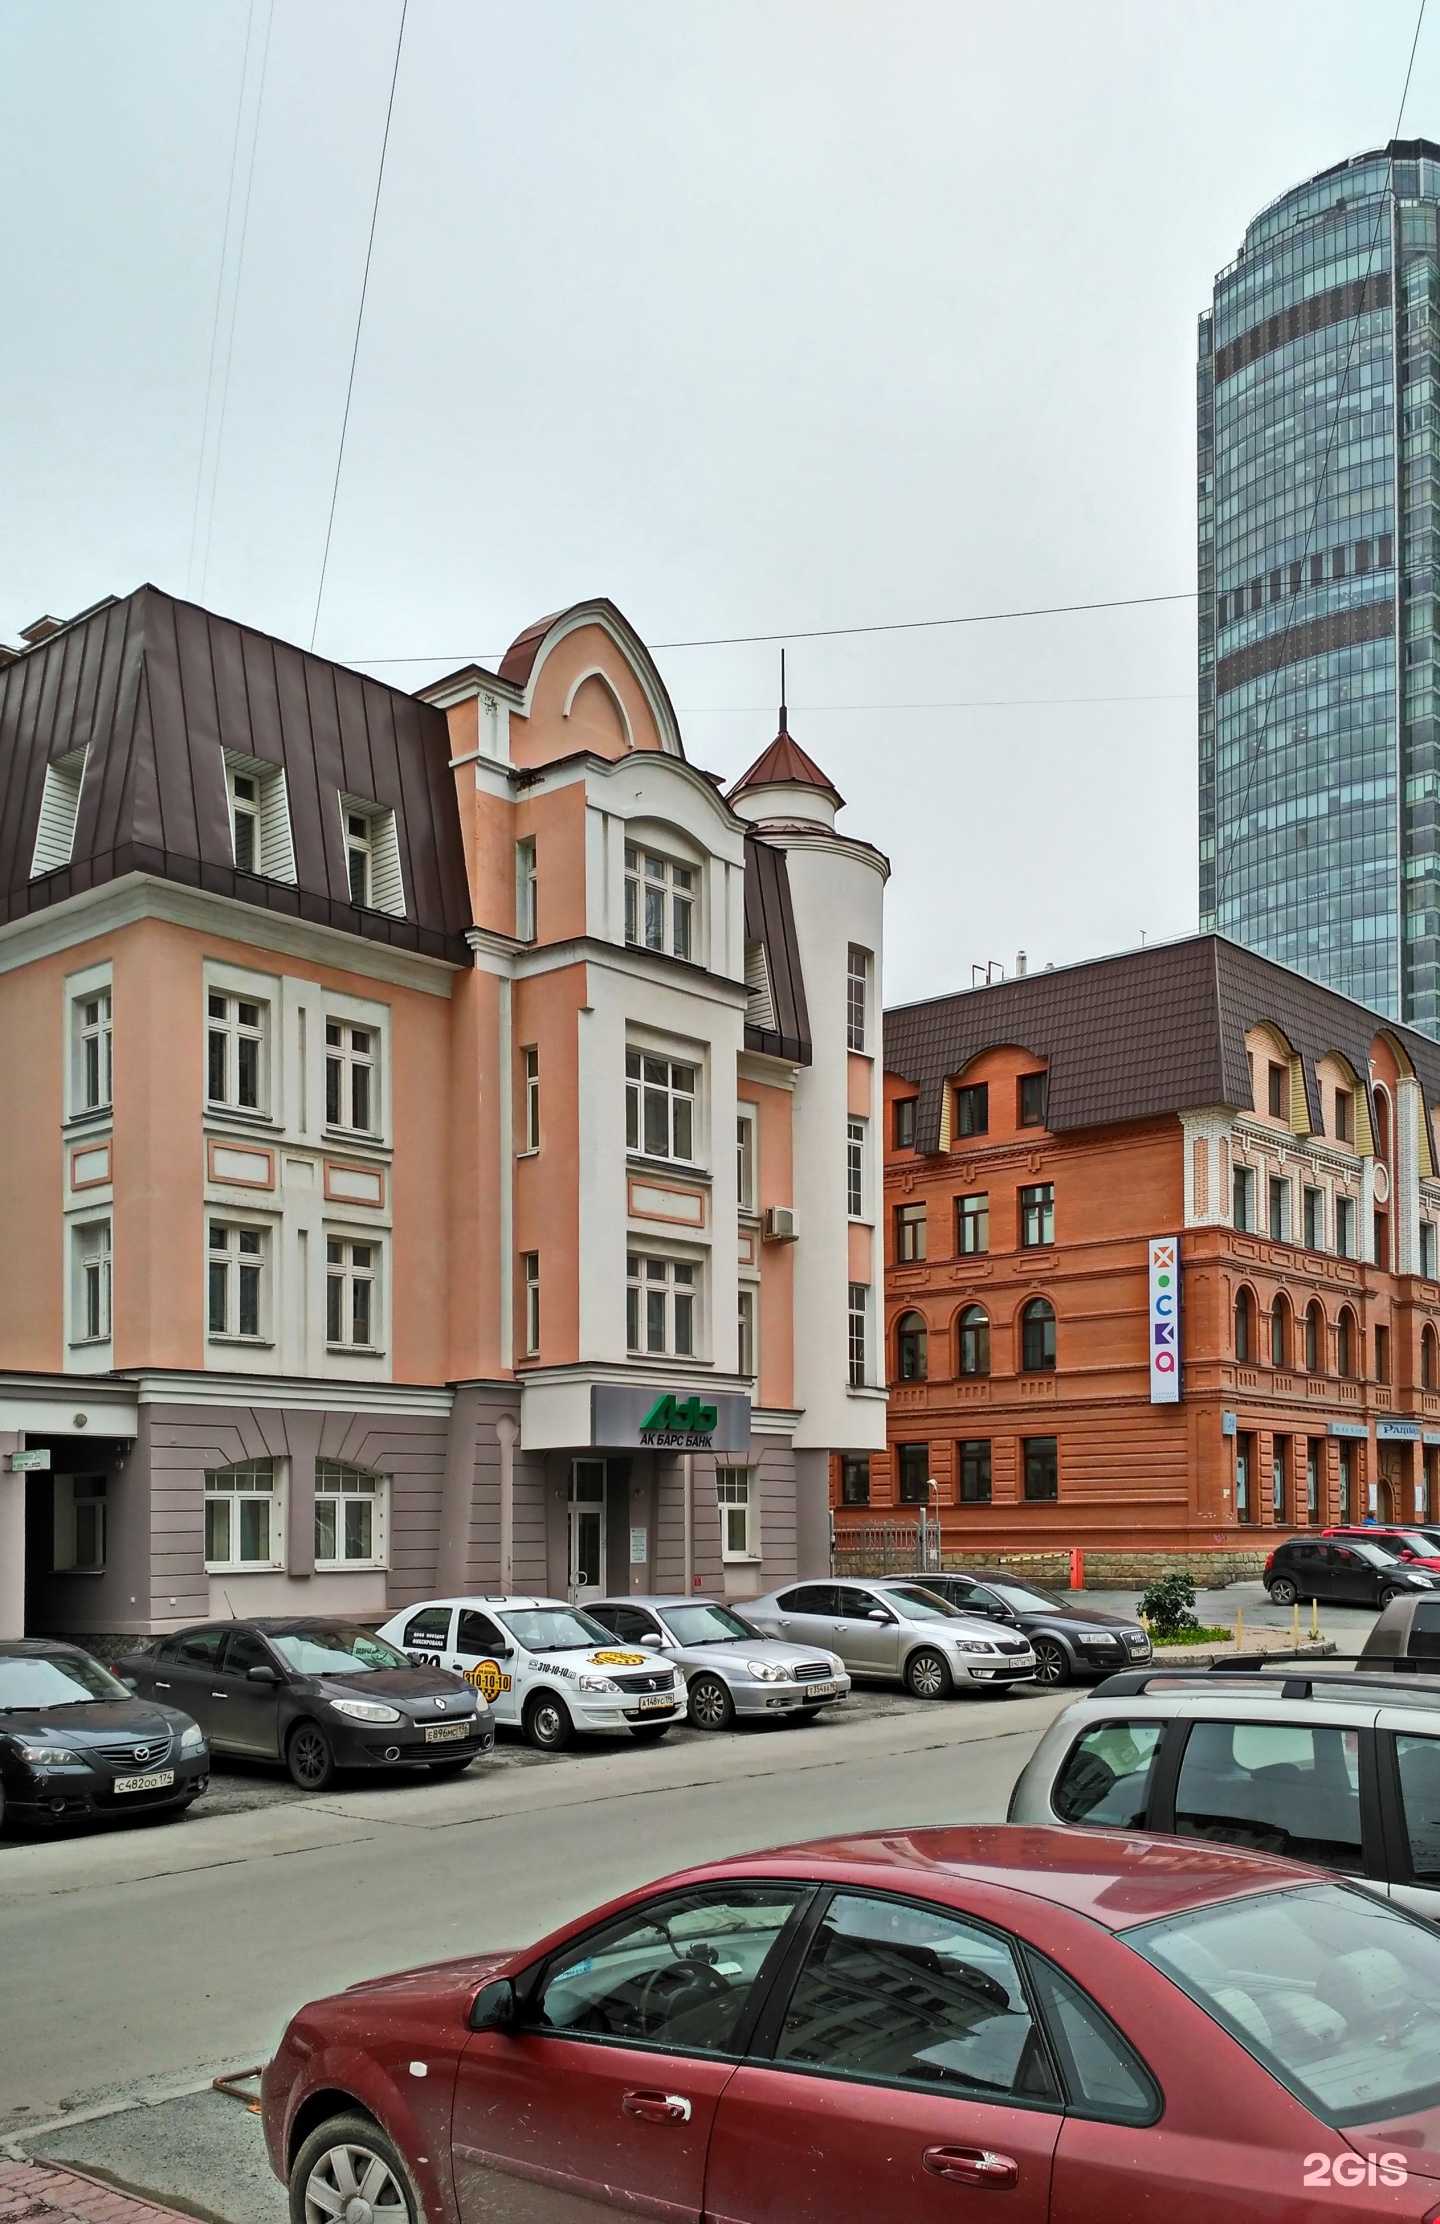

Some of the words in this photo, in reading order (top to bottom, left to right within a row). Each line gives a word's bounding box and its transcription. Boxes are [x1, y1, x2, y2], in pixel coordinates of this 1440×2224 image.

[640, 1433, 655, 1445] АК
[657, 1433, 684, 1446] БАРС
[686, 1435, 712, 1448] БАНК
